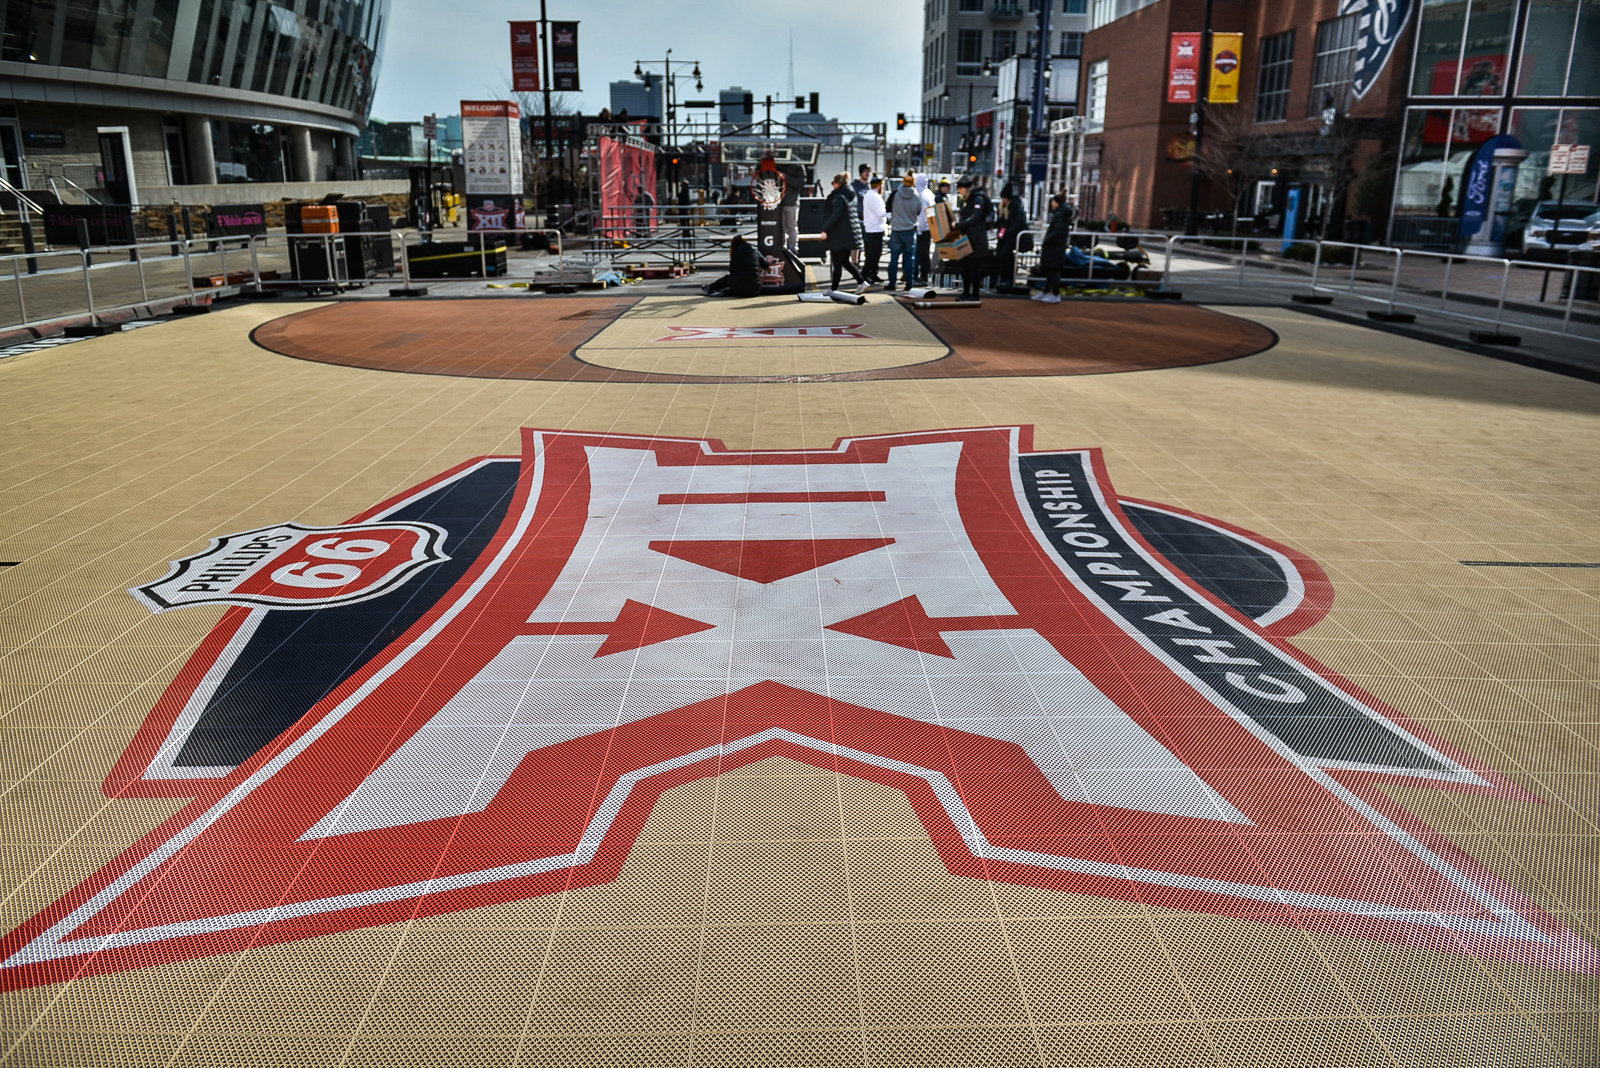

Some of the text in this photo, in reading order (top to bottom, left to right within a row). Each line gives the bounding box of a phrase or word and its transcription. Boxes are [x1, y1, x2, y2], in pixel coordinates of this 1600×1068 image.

[463, 104, 505, 112] WELCOME
[1467, 160, 1489, 204] Ford
[764, 235, 774, 247] G
[177, 534, 293, 593] PHILLIPS
[270, 537, 391, 589] 66
[1035, 468, 1307, 704] CHAMPIONSHIP
